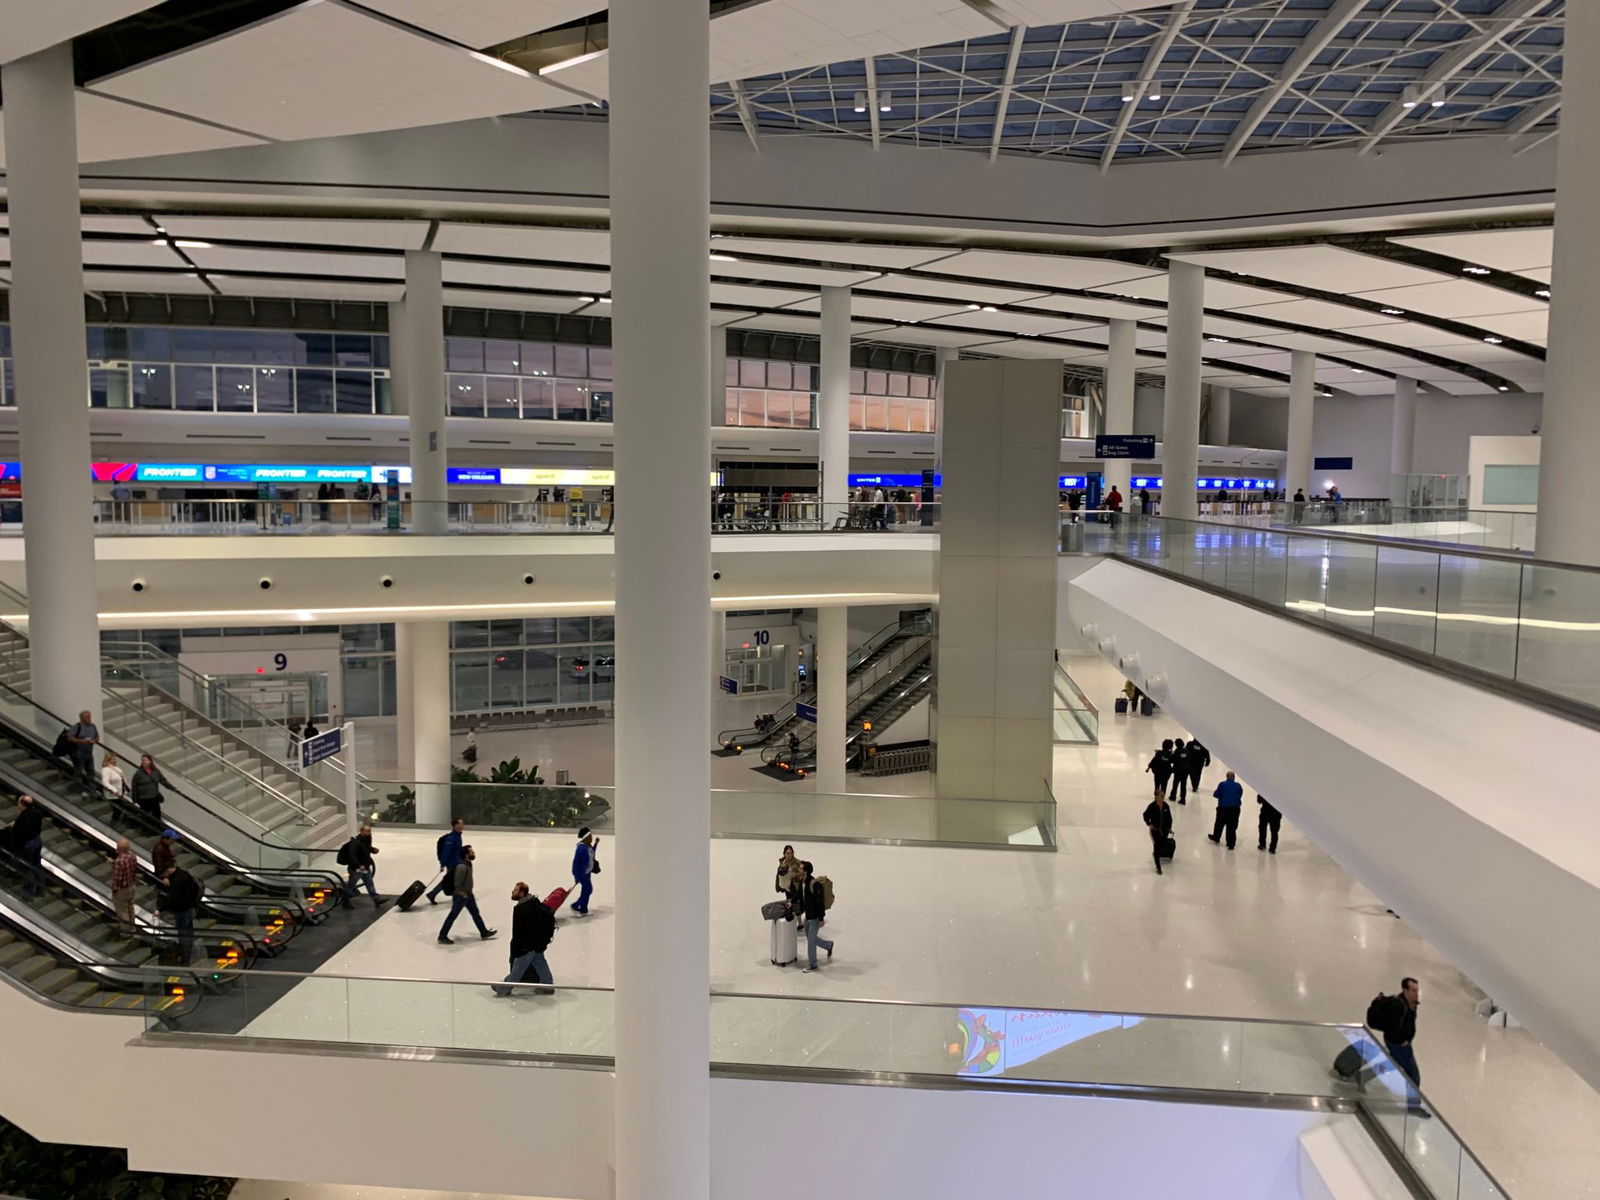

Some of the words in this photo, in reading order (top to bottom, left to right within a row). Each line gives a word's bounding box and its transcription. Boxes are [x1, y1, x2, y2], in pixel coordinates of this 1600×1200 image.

[143, 468, 197, 476] FRONTIER
[255, 469, 307, 477] FRONTIER
[317, 470, 367, 478] FRONTIER
[753, 630, 770, 645] 10
[274, 653, 288, 671] 9
